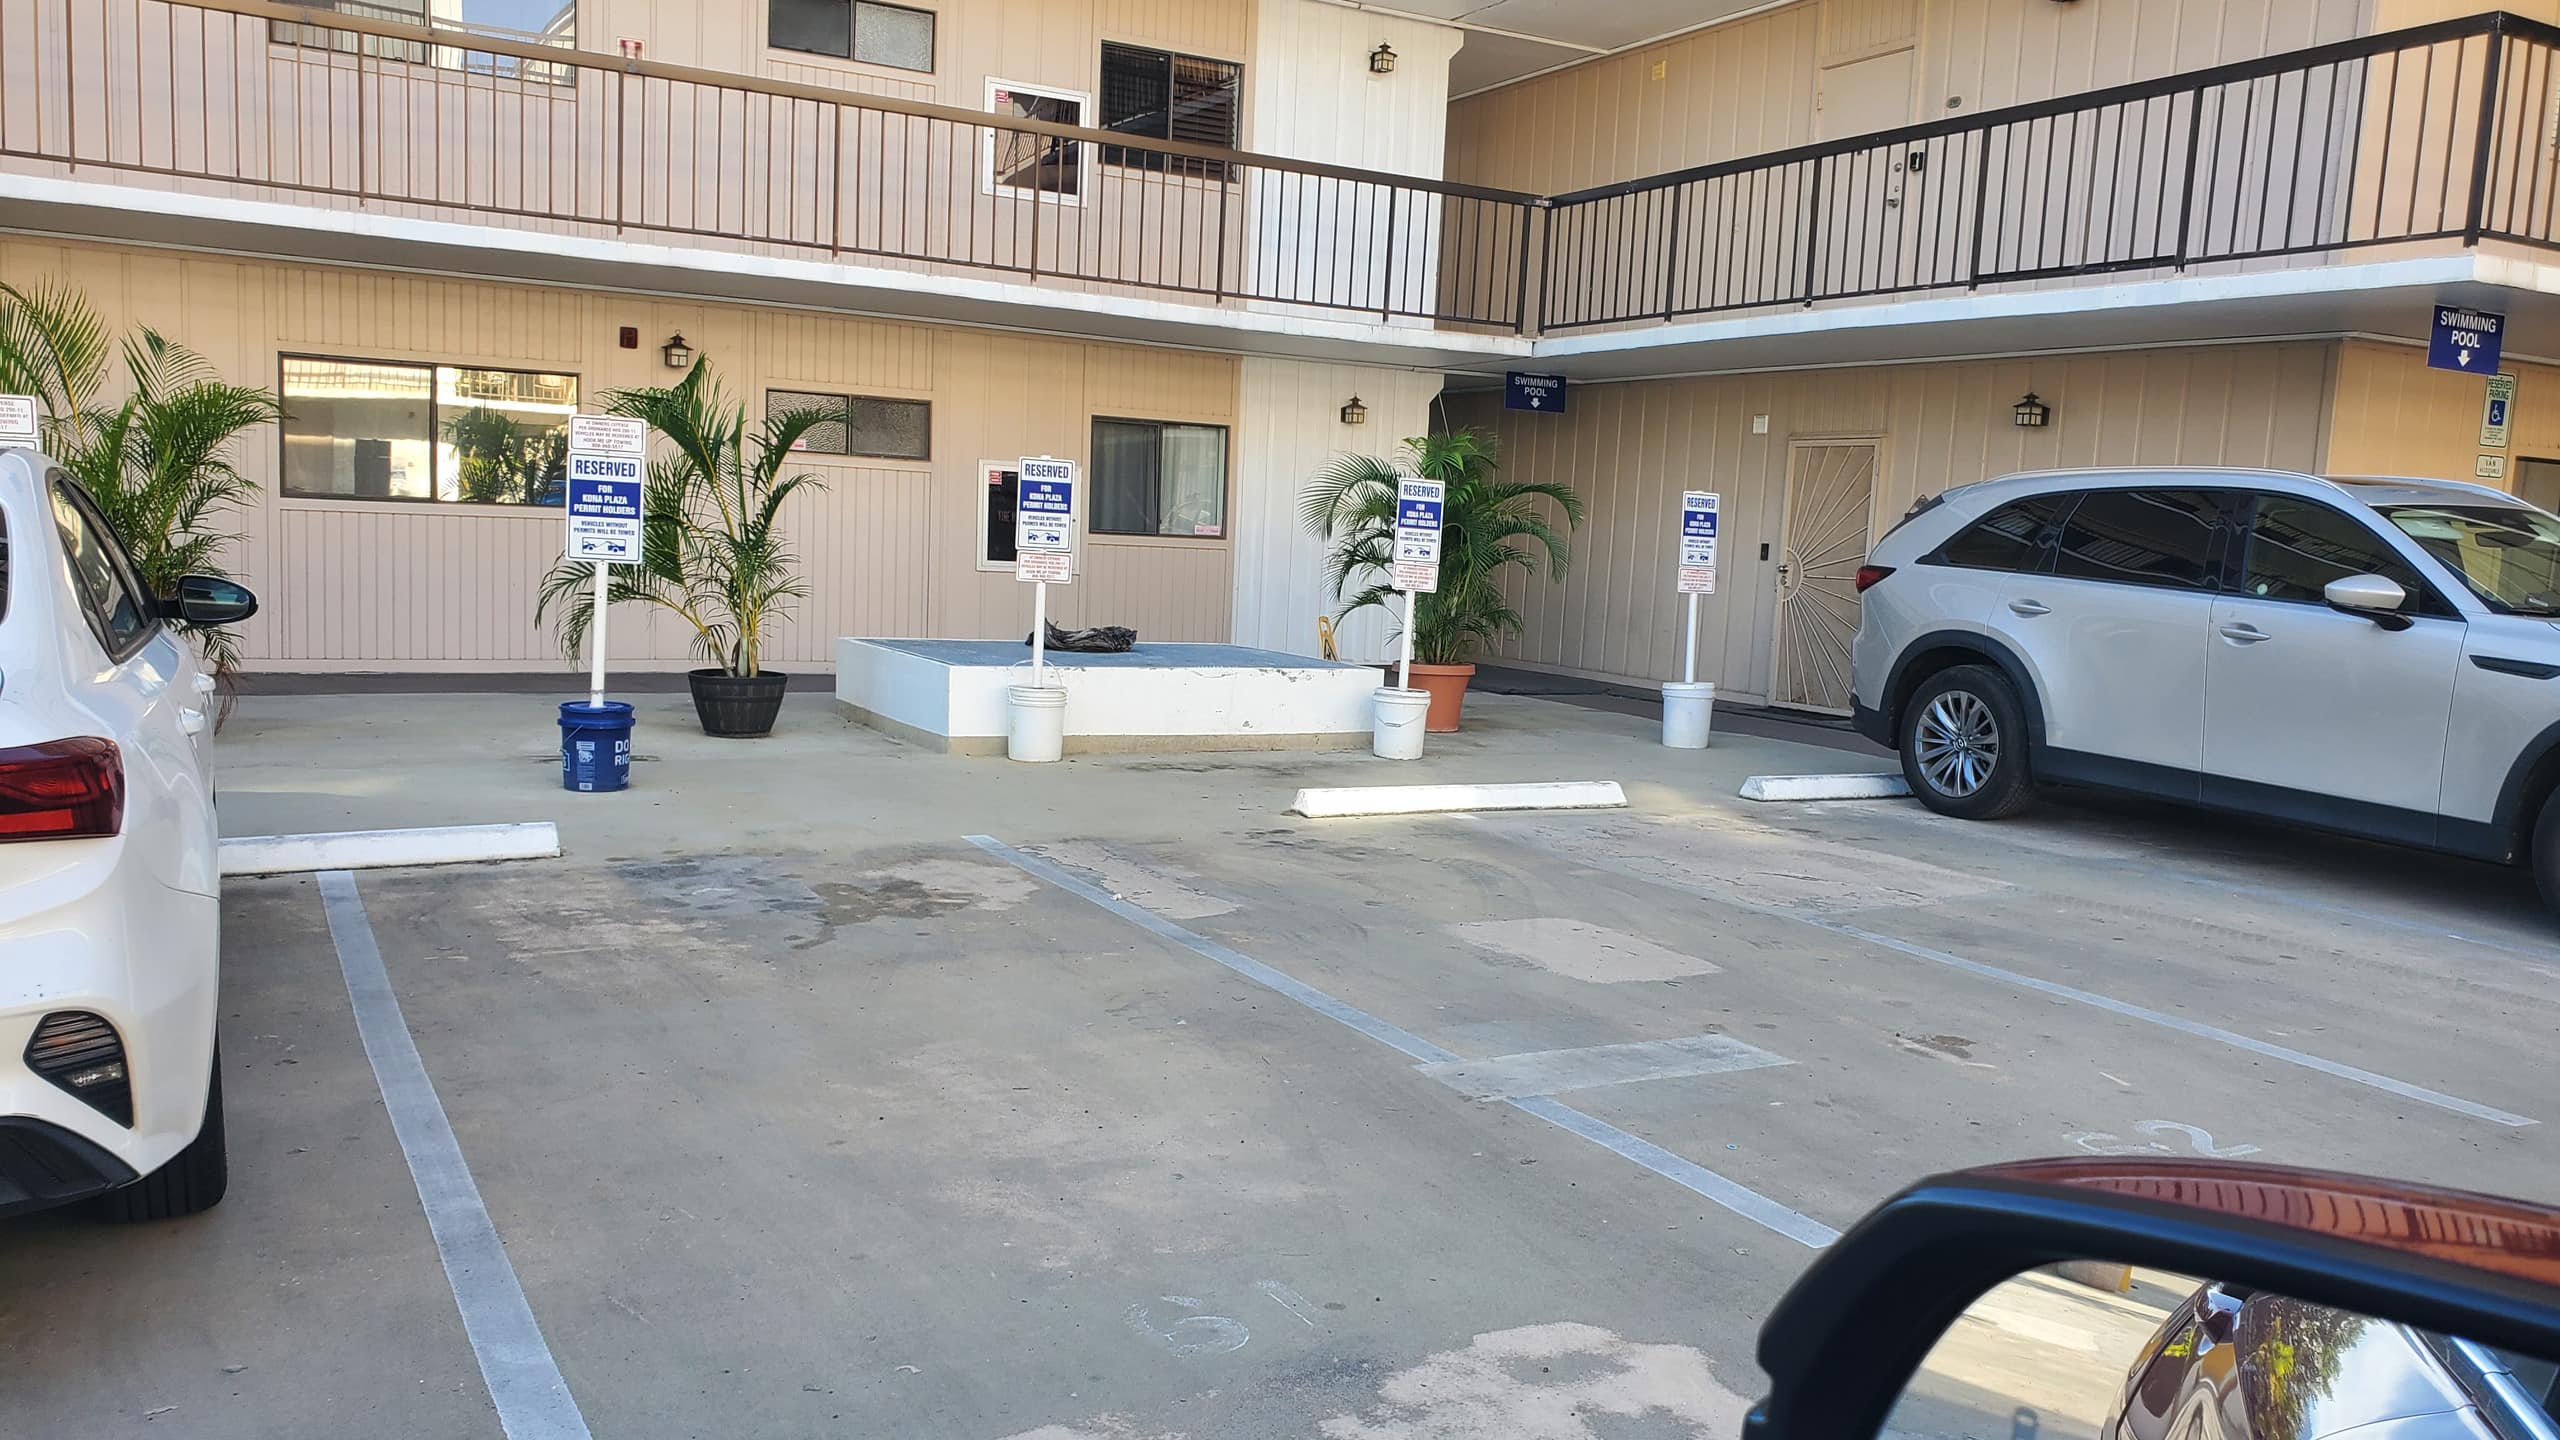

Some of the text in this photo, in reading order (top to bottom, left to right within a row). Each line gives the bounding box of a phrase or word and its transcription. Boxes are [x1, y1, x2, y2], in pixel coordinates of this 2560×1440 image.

[2441, 311, 2496, 333] SWIMMING
[2451, 330, 2480, 348] POOL
[1515, 376, 1558, 388] SWIMMING
[2488, 379, 2512, 390] RESERVED
[1524, 387, 1547, 397] POOL
[2489, 389, 2510, 400] PARKING
[576, 460, 636, 477] RESERVED
[1025, 464, 1069, 478] RESERVED
[598, 485, 613, 493] FOR
[1403, 485, 1440, 498] RESERVED
[582, 494, 628, 504] KONA PLAZA
[1023, 501, 1043, 509] PERMIT
[1687, 497, 1715, 509] RESERVED
[574, 504, 636, 515] PERMIT HOLDERS
[615, 739, 629, 753] DO
